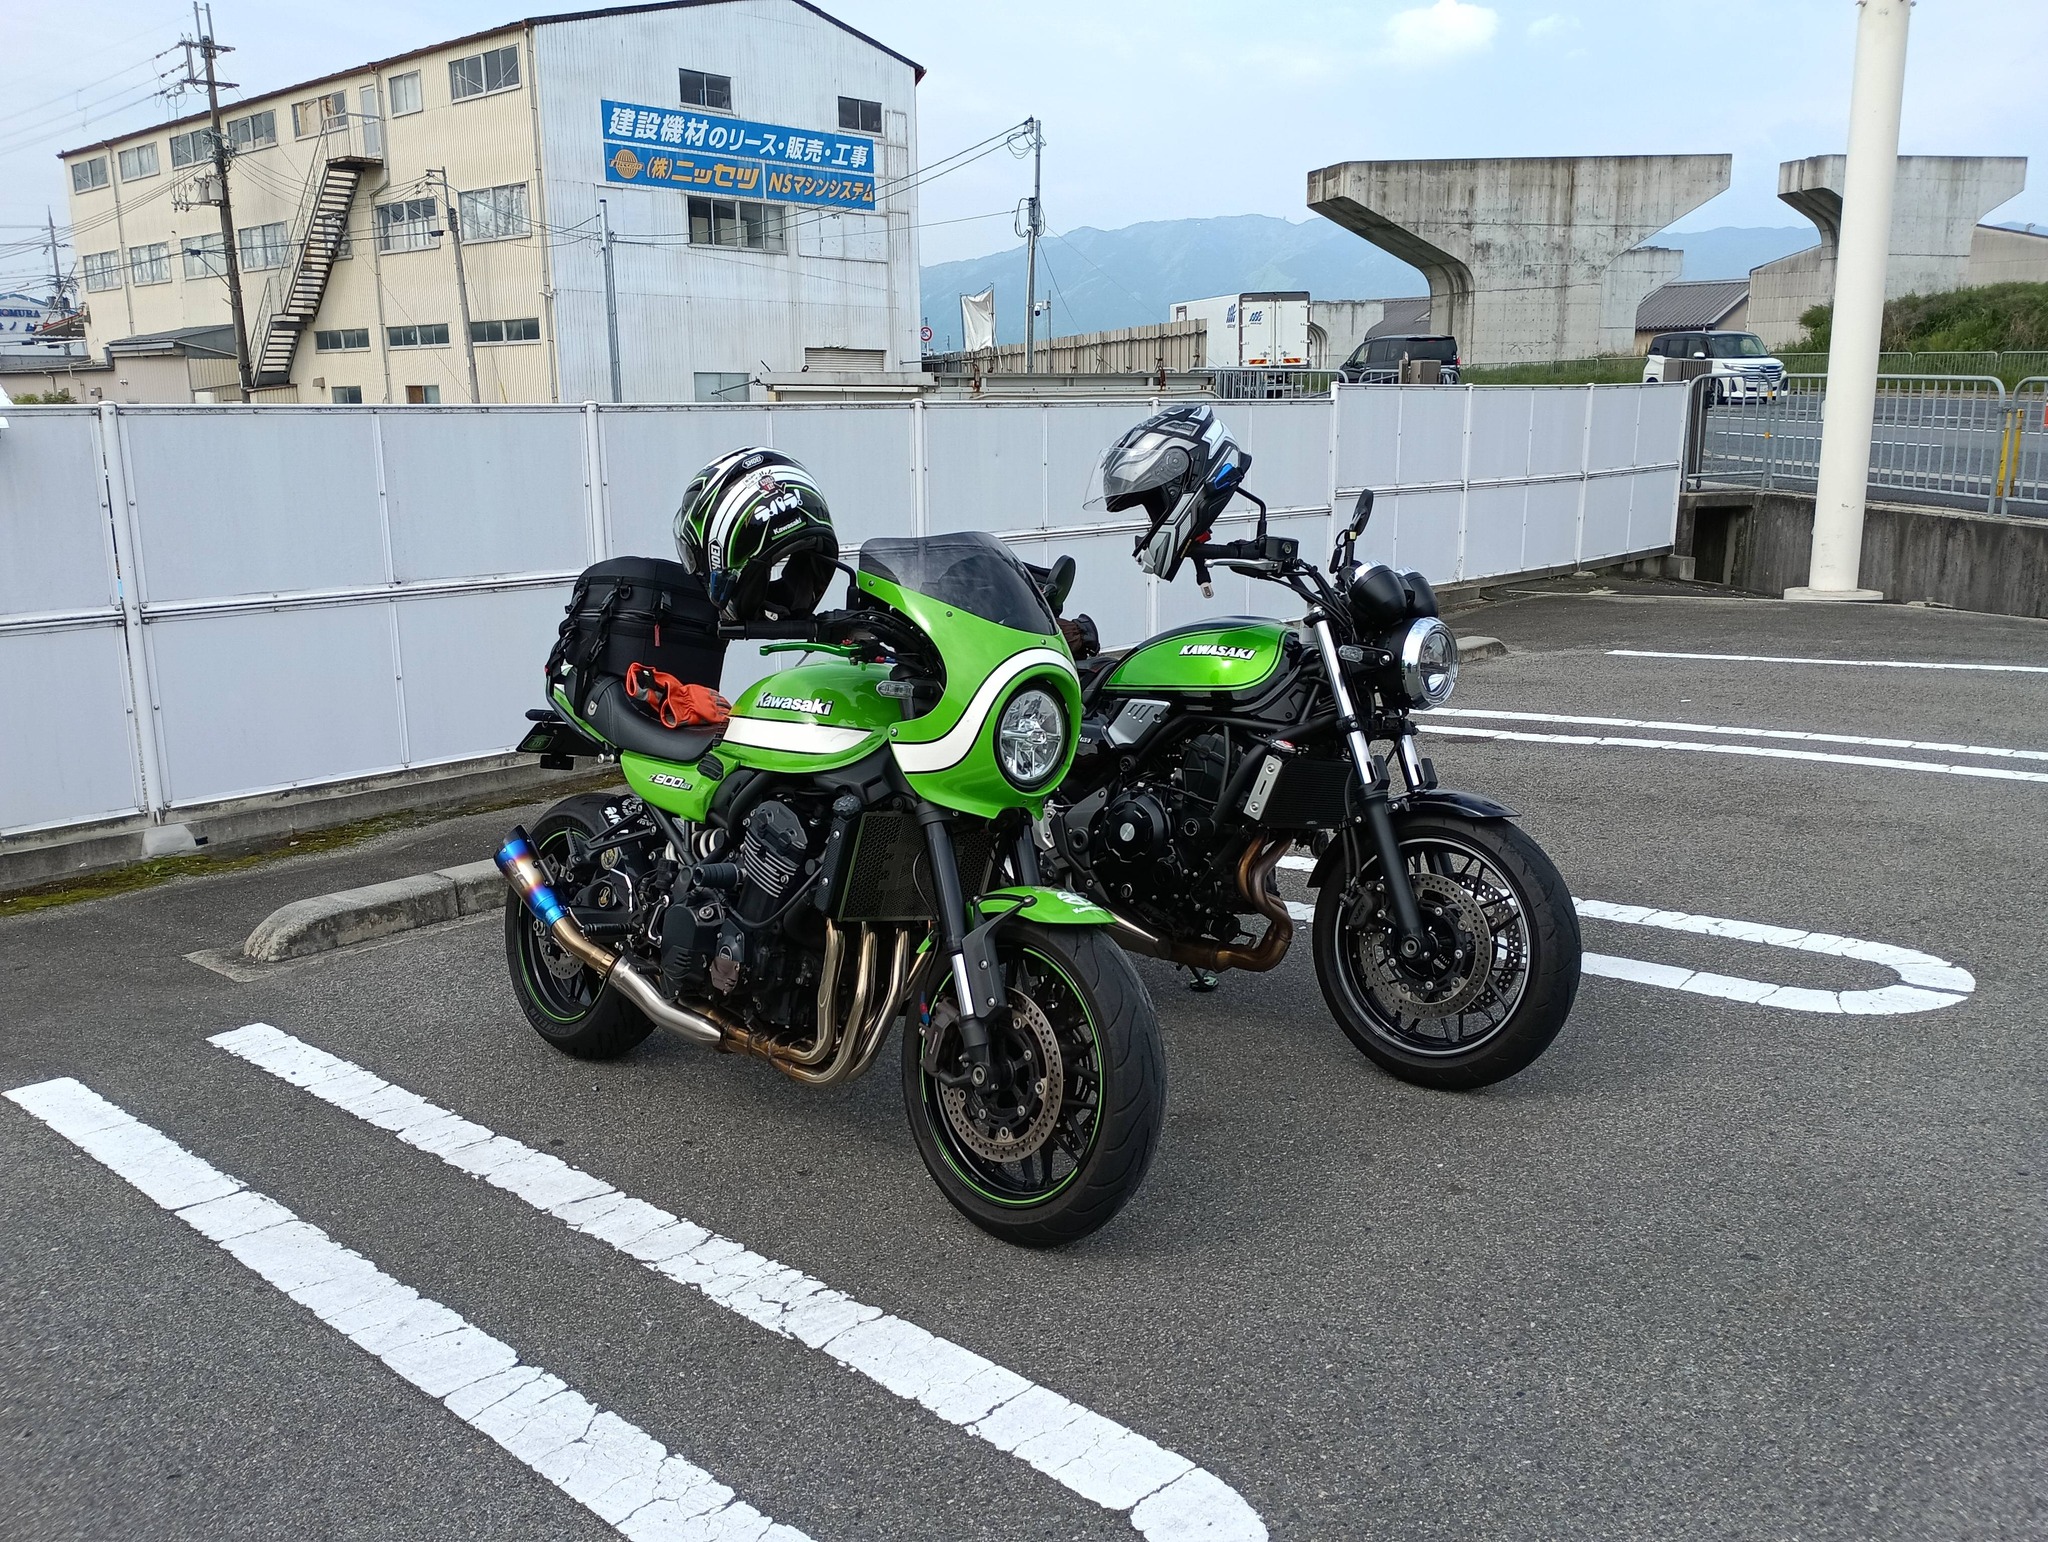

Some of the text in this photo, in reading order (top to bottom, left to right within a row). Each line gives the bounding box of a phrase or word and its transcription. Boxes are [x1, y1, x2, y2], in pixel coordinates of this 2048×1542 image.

[608, 107, 869, 169] 建設機材のリース・販売・工事
[0, 309, 40, 317] OMURA
[1179, 644, 1256, 660] KAWASAKI
[756, 692, 833, 716] Kawasaki
